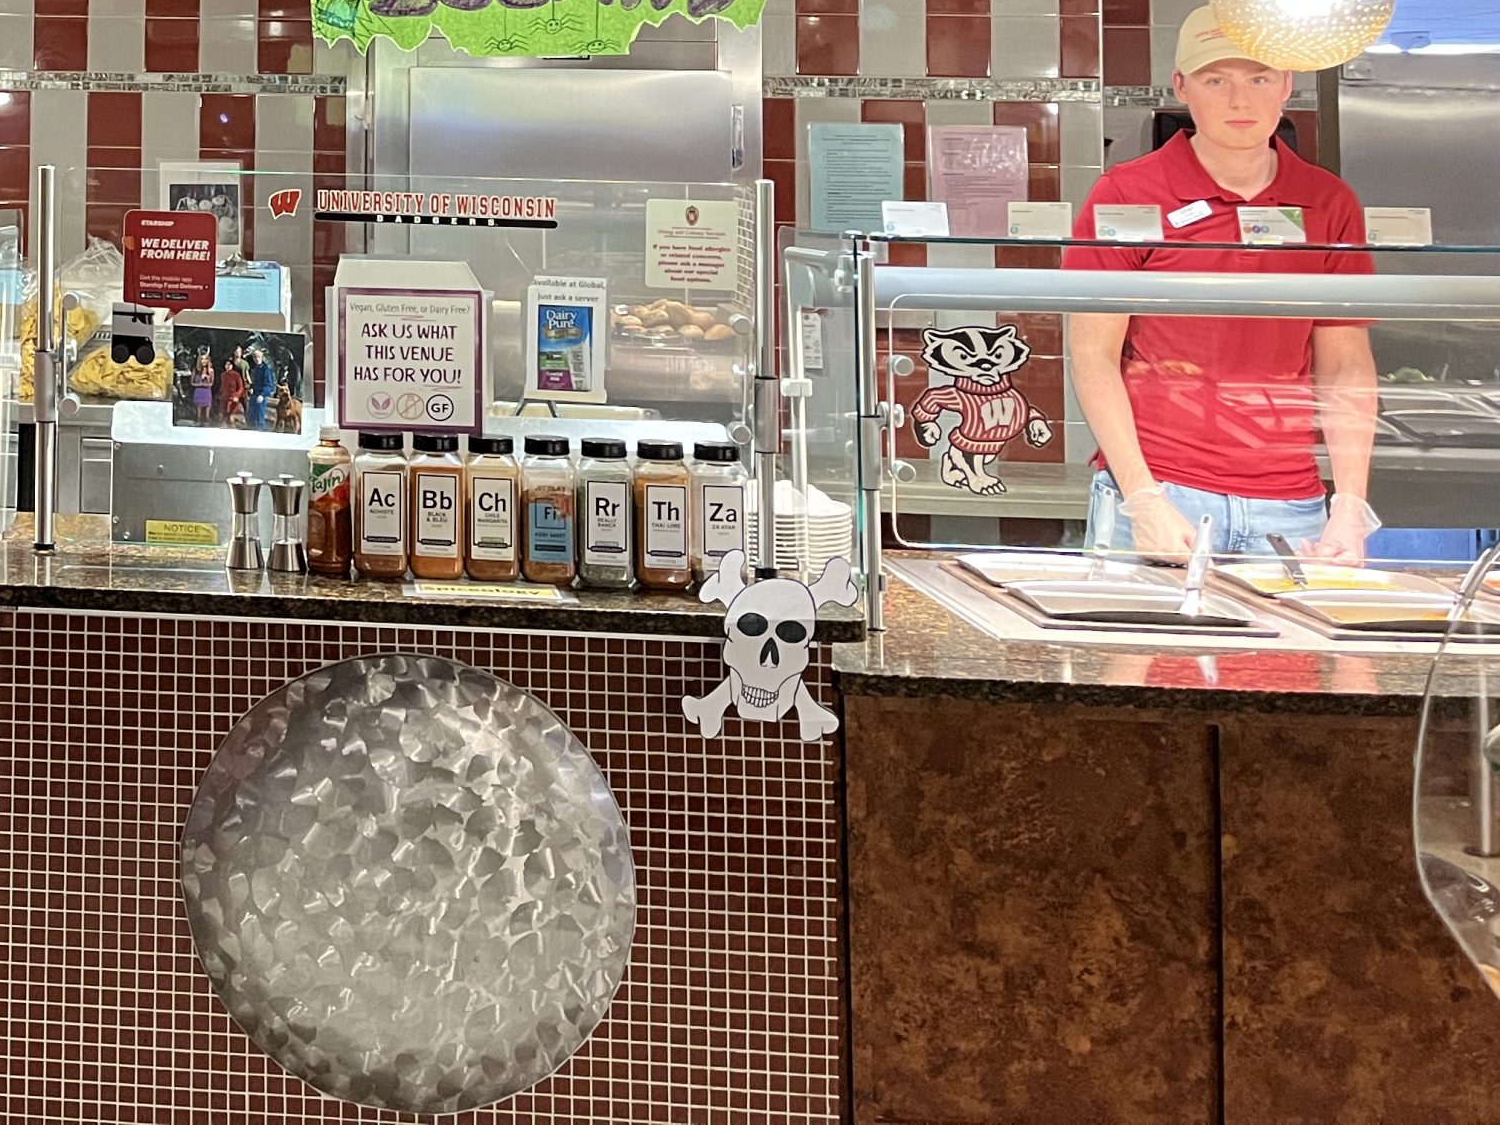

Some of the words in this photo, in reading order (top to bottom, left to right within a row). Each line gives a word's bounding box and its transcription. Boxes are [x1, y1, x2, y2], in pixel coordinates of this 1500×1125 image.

[317, 190, 424, 214] UNIVERSITY
[429, 193, 451, 215] OF
[455, 194, 557, 218] WISCONSIN
[141, 237, 160, 248] WE
[160, 238, 210, 250] DELIVER
[140, 248, 175, 260] FROM
[176, 250, 211, 261] HERE!
[350, 302, 375, 313] Vegan,
[375, 303, 400, 313] Gluten
[401, 304, 419, 314] Free,
[429, 305, 449, 315] Dairy
[450, 305, 471, 315] Free?
[545, 309, 578, 321] Dairy
[361, 323, 388, 338] ASK
[392, 324, 412, 339] US
[417, 325, 457, 340] WHAT
[548, 319, 576, 330] Pure
[365, 345, 395, 360] THIS
[400, 346, 454, 362] VENUE
[354, 366, 379, 381] HAS
[383, 367, 415, 382] FOR
[419, 368, 462, 384] YOU!
[430, 403, 449, 413] GF
[368, 487, 396, 508] Ac
[422, 490, 452, 510] Bb
[478, 492, 506, 512] Ch
[595, 497, 620, 517] Rr
[652, 501, 680, 521] Th
[709, 502, 737, 522] Za
[163, 523, 201, 533] NOTICE
